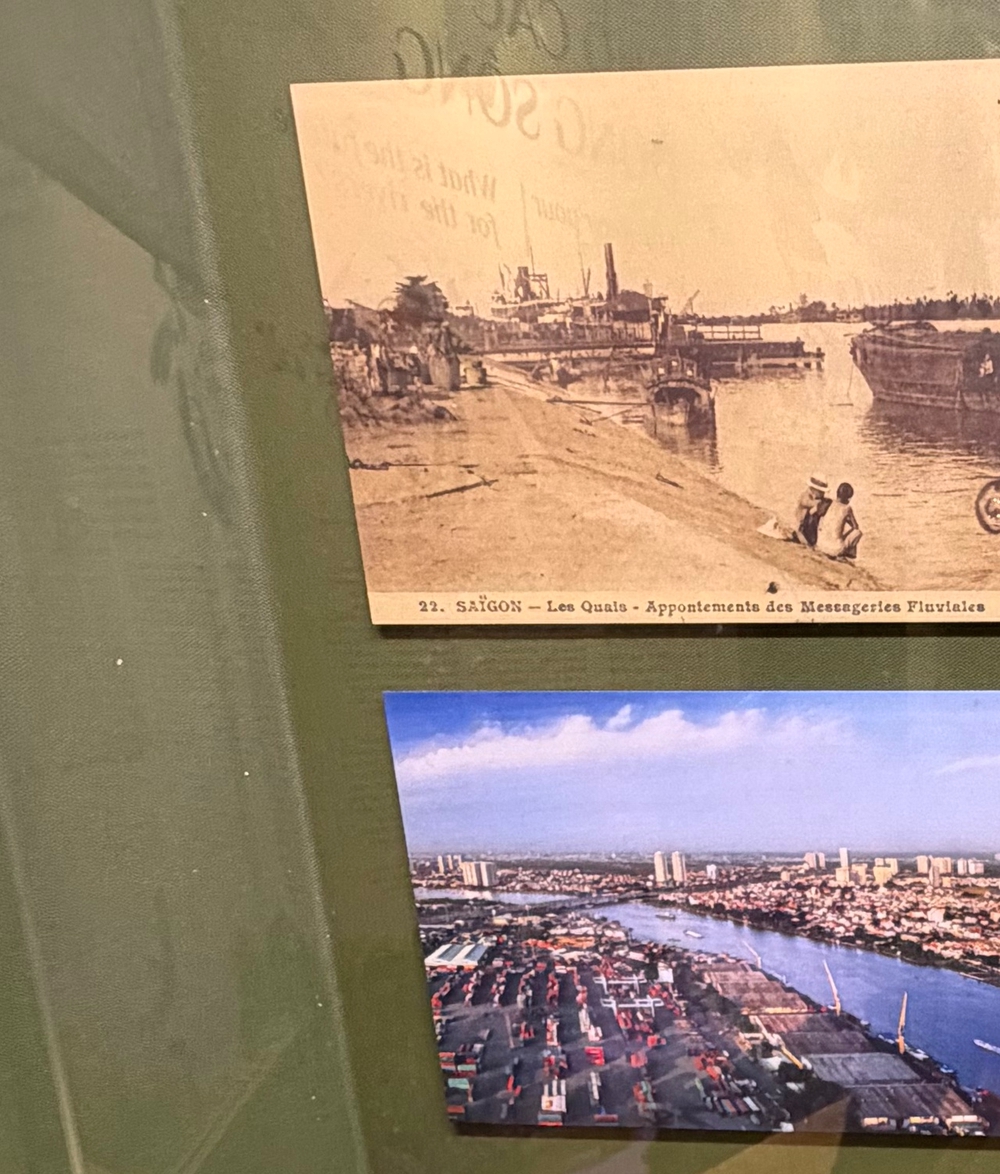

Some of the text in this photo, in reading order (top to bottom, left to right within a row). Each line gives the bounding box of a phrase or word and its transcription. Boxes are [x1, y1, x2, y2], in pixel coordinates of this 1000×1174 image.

[419, 600, 445, 613] 22.
[456, 595, 522, 613] SAÏGON
[547, 600, 575, 613] Les
[581, 600, 628, 614] Quais
[645, 600, 760, 617] Appontements
[765, 600, 793, 613] des
[800, 600, 902, 616] Messageries
[907, 600, 986, 613] Fluviales
